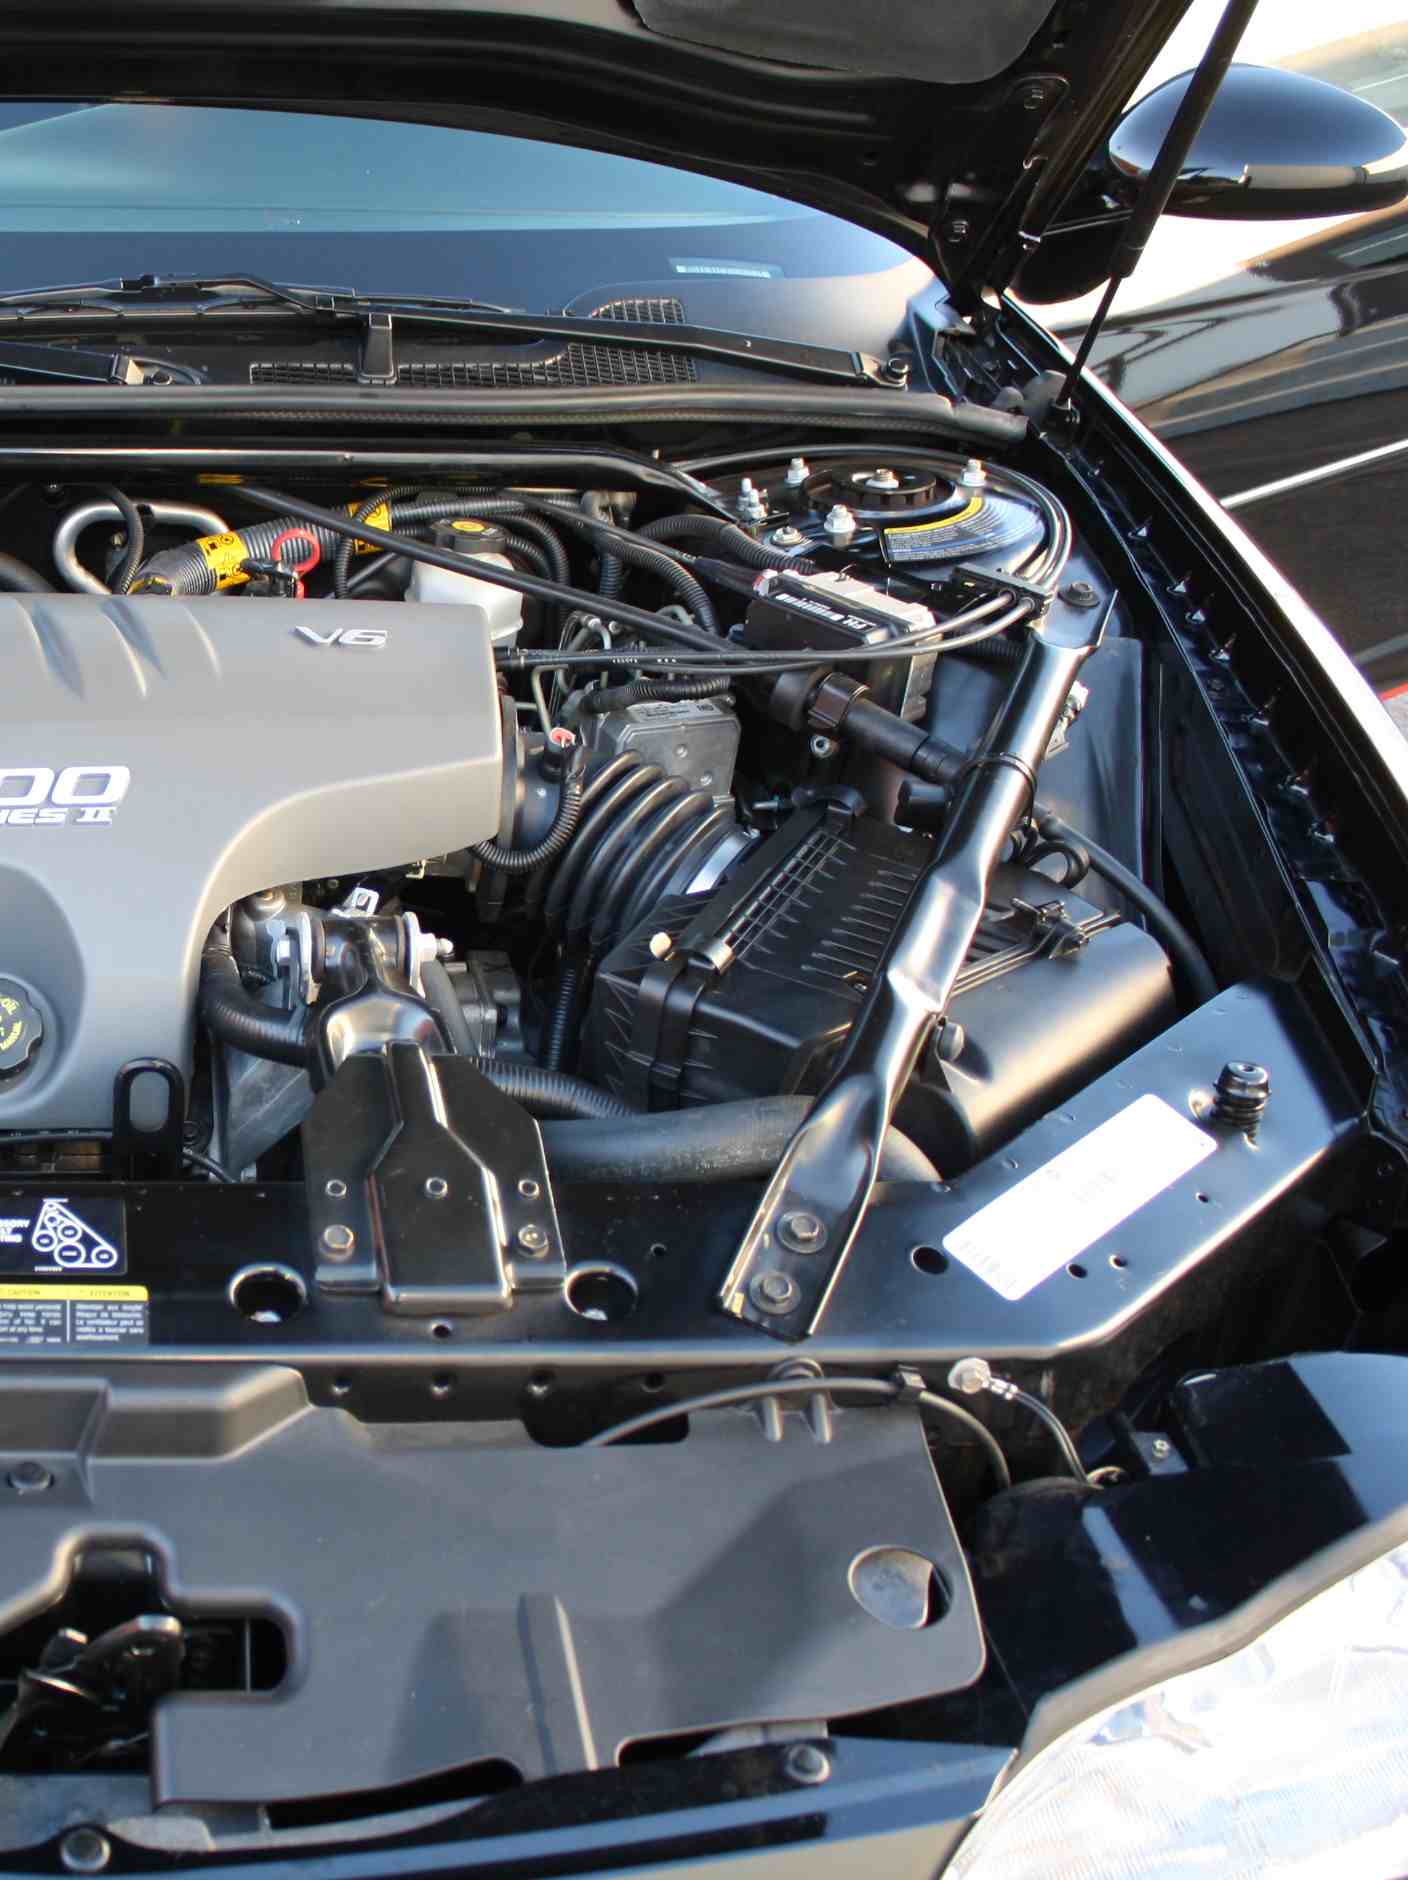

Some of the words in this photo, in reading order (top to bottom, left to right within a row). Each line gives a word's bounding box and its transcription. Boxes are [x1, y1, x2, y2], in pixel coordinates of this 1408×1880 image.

[294, 625, 388, 648] V6
[75, 806, 117, 825] II
[1, 997, 18, 1015] OIL
